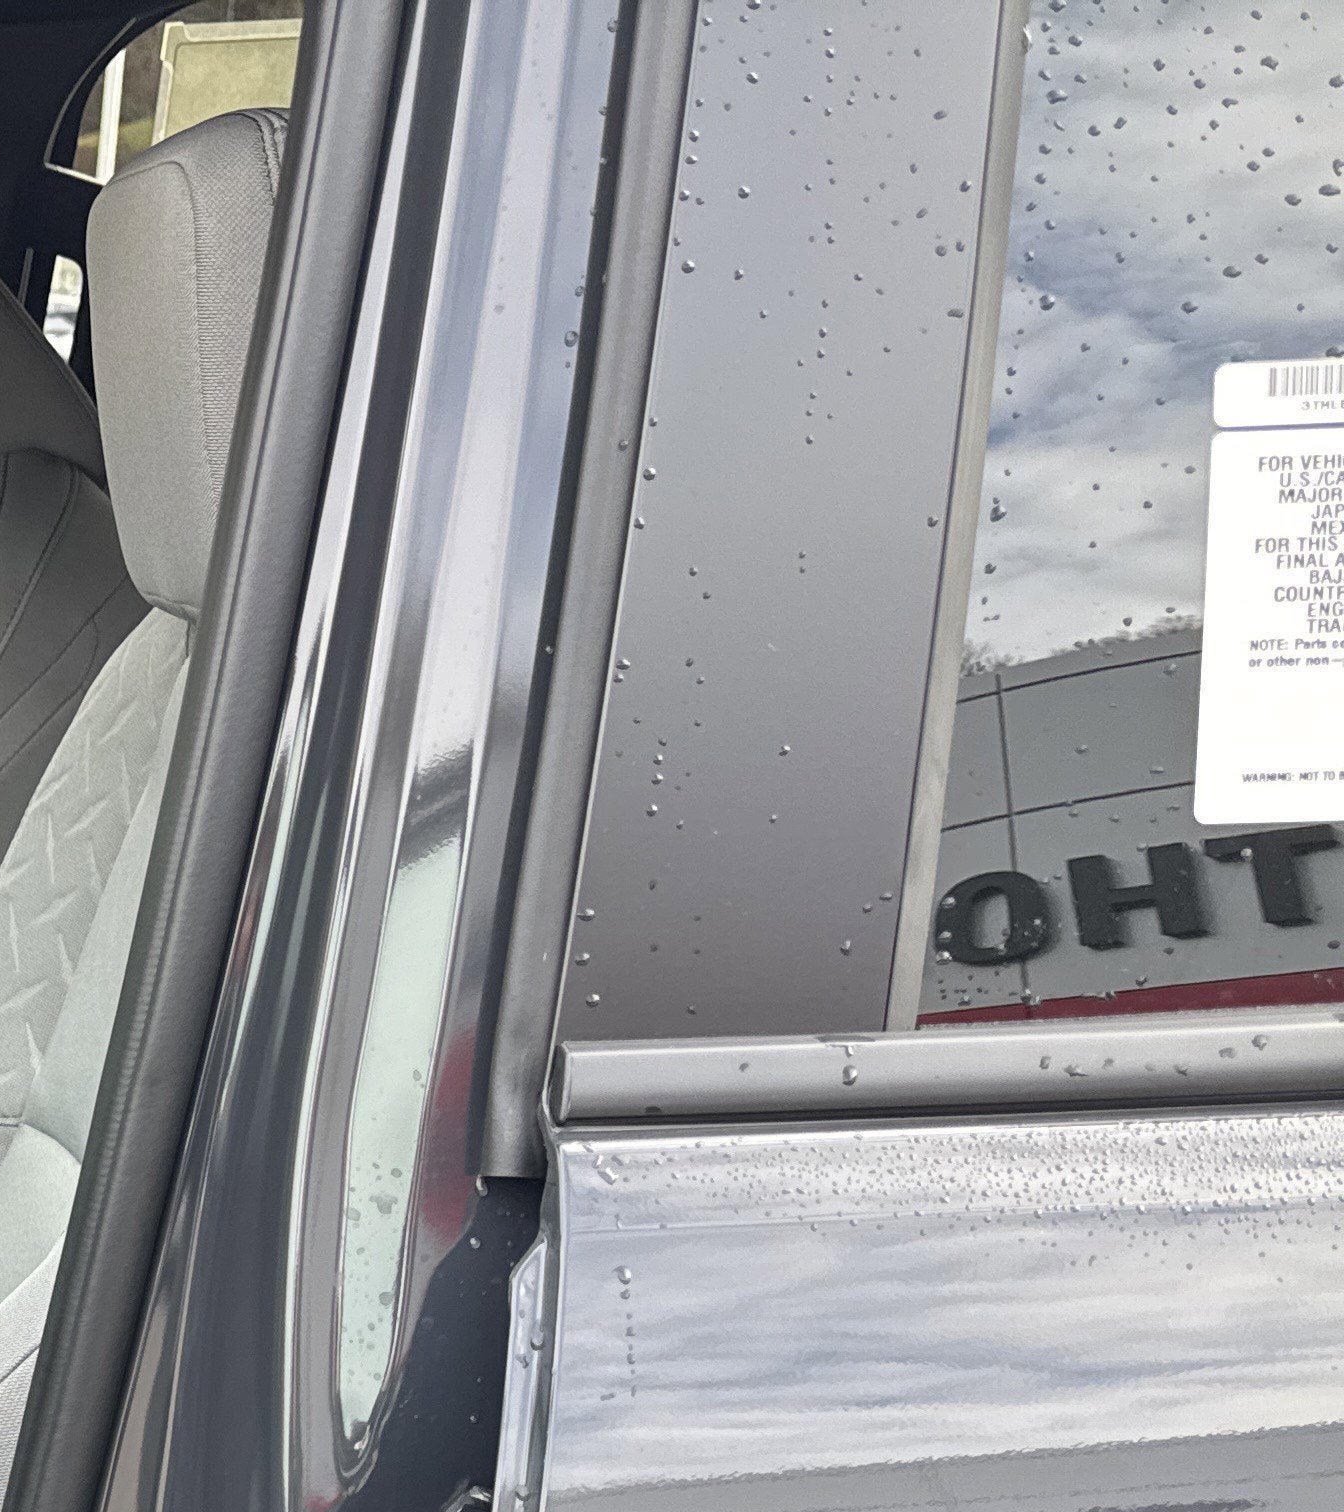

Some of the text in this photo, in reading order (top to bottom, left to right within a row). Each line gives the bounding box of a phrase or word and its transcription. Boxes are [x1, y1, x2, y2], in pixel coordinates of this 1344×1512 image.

[1258, 454, 1344, 472] FOR VEHI
[1278, 487, 1343, 503] MAJOR
[1255, 536, 1339, 553] FOR THIS
[1276, 553, 1329, 569] FINAL
[1250, 638, 1289, 651] NOTE:
[1295, 638, 1328, 650] Parts
[1248, 658, 1263, 667] or
[1267, 655, 1301, 667] other
